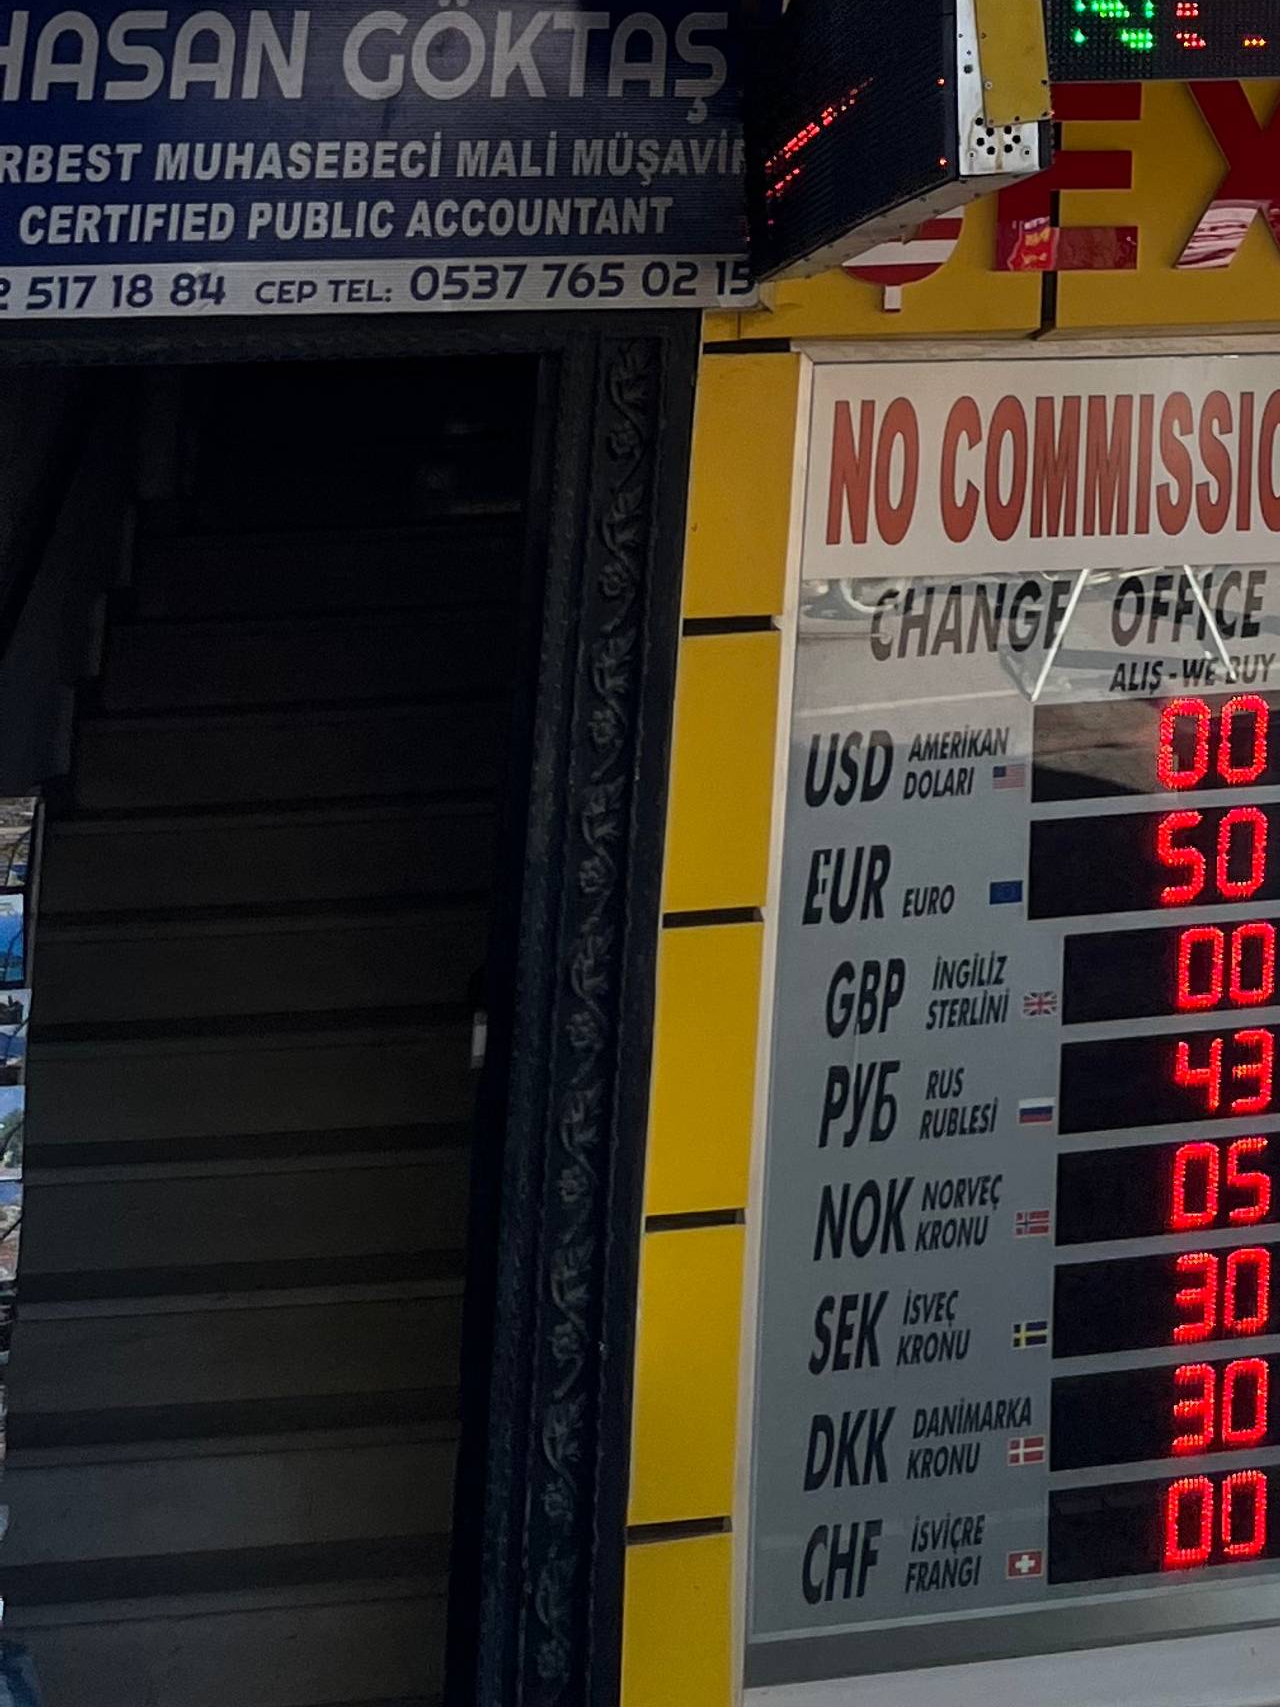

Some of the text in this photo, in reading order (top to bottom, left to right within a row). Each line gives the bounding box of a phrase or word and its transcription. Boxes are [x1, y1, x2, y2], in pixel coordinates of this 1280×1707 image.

[155, 132, 442, 182] MUHASEBECİ
[455, 130, 557, 179] MALİ
[19, 196, 673, 245] CERTIFIED PUBLIC ACCOUNTANT
[26, 260, 758, 311] 517 18 84 CEP TEL: 0537 765 02 15
[826, 396, 919, 545] NO
[869, 570, 1267, 662] CHANGE OFFICE
[1109, 660, 1163, 694] ALIŞ
[1183, 658, 1216, 687] WE
[1226, 653, 1276, 684] BUY
[805, 724, 1009, 807] USD AMERİKAN
[903, 767, 975, 800] DOLARI
[1157, 693, 1269, 790] 00
[802, 844, 955, 925] EUR EURO
[1157, 806, 1268, 907] 50
[826, 955, 1007, 1040] GBP İNGİLİZ
[1177, 921, 1275, 1010] 00
[925, 991, 1009, 1030] STERLİNİ
[818, 1061, 900, 1148] РУБ
[926, 1067, 965, 1100] RUS
[1174, 1027, 1274, 1113] 43
[919, 1100, 998, 1140] RUBLESİ
[813, 1173, 1003, 1262] NOK NORVEÇ
[1172, 1137, 1271, 1232] 05
[915, 1214, 989, 1252] KRONU
[808, 1288, 960, 1376] SEK İSVEÇ
[1173, 1247, 1270, 1344] 30
[899, 1327, 970, 1367] KRONU
[804, 1395, 1033, 1491] DKK DANİMARKA
[1171, 1357, 1268, 1454] 30
[906, 1442, 981, 1481] KRONU
[801, 1513, 987, 1605] CHF İSVİÇRE
[1165, 1469, 1268, 1571] 00
[905, 1555, 981, 1594] FRANGI
